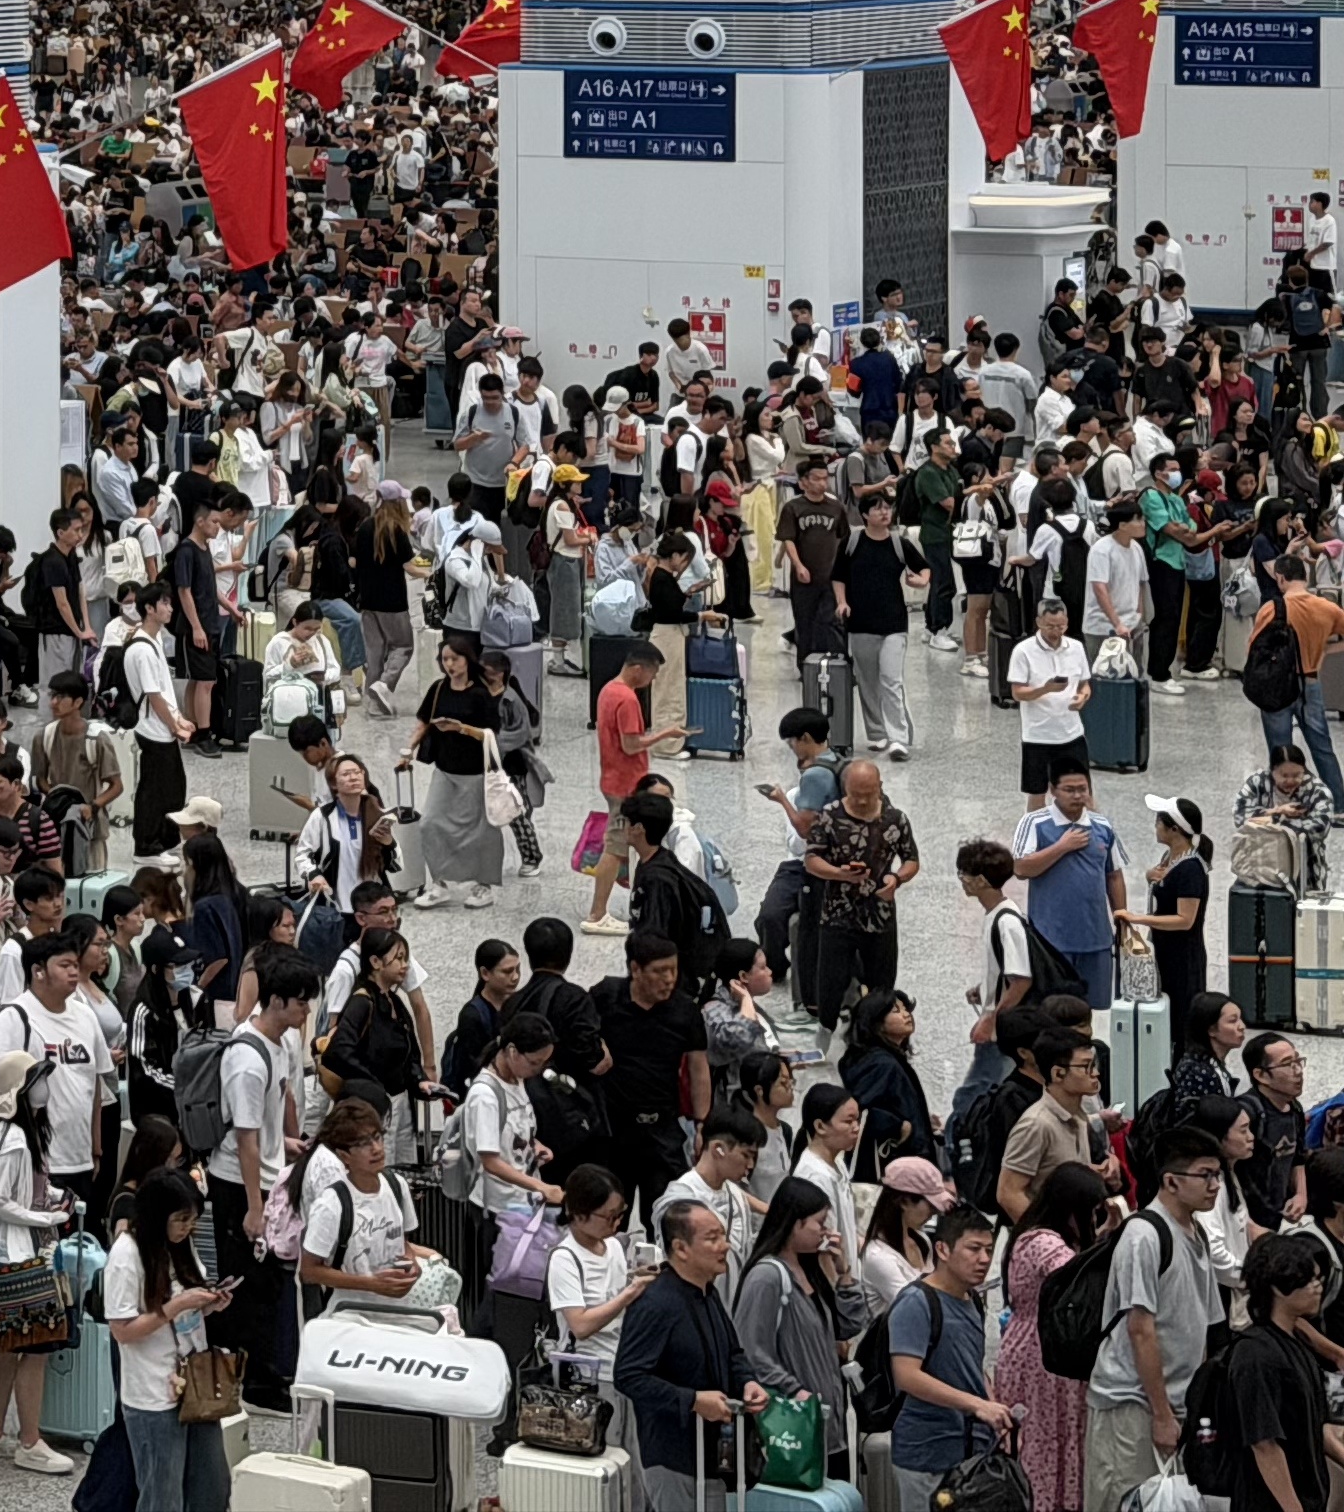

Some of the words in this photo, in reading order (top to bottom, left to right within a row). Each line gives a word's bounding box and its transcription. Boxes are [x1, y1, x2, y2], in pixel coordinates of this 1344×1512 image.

[1233, 47, 1255, 62] A1
[631, 110, 657, 129] A1
[327, 1349, 470, 1382] LI-NING
